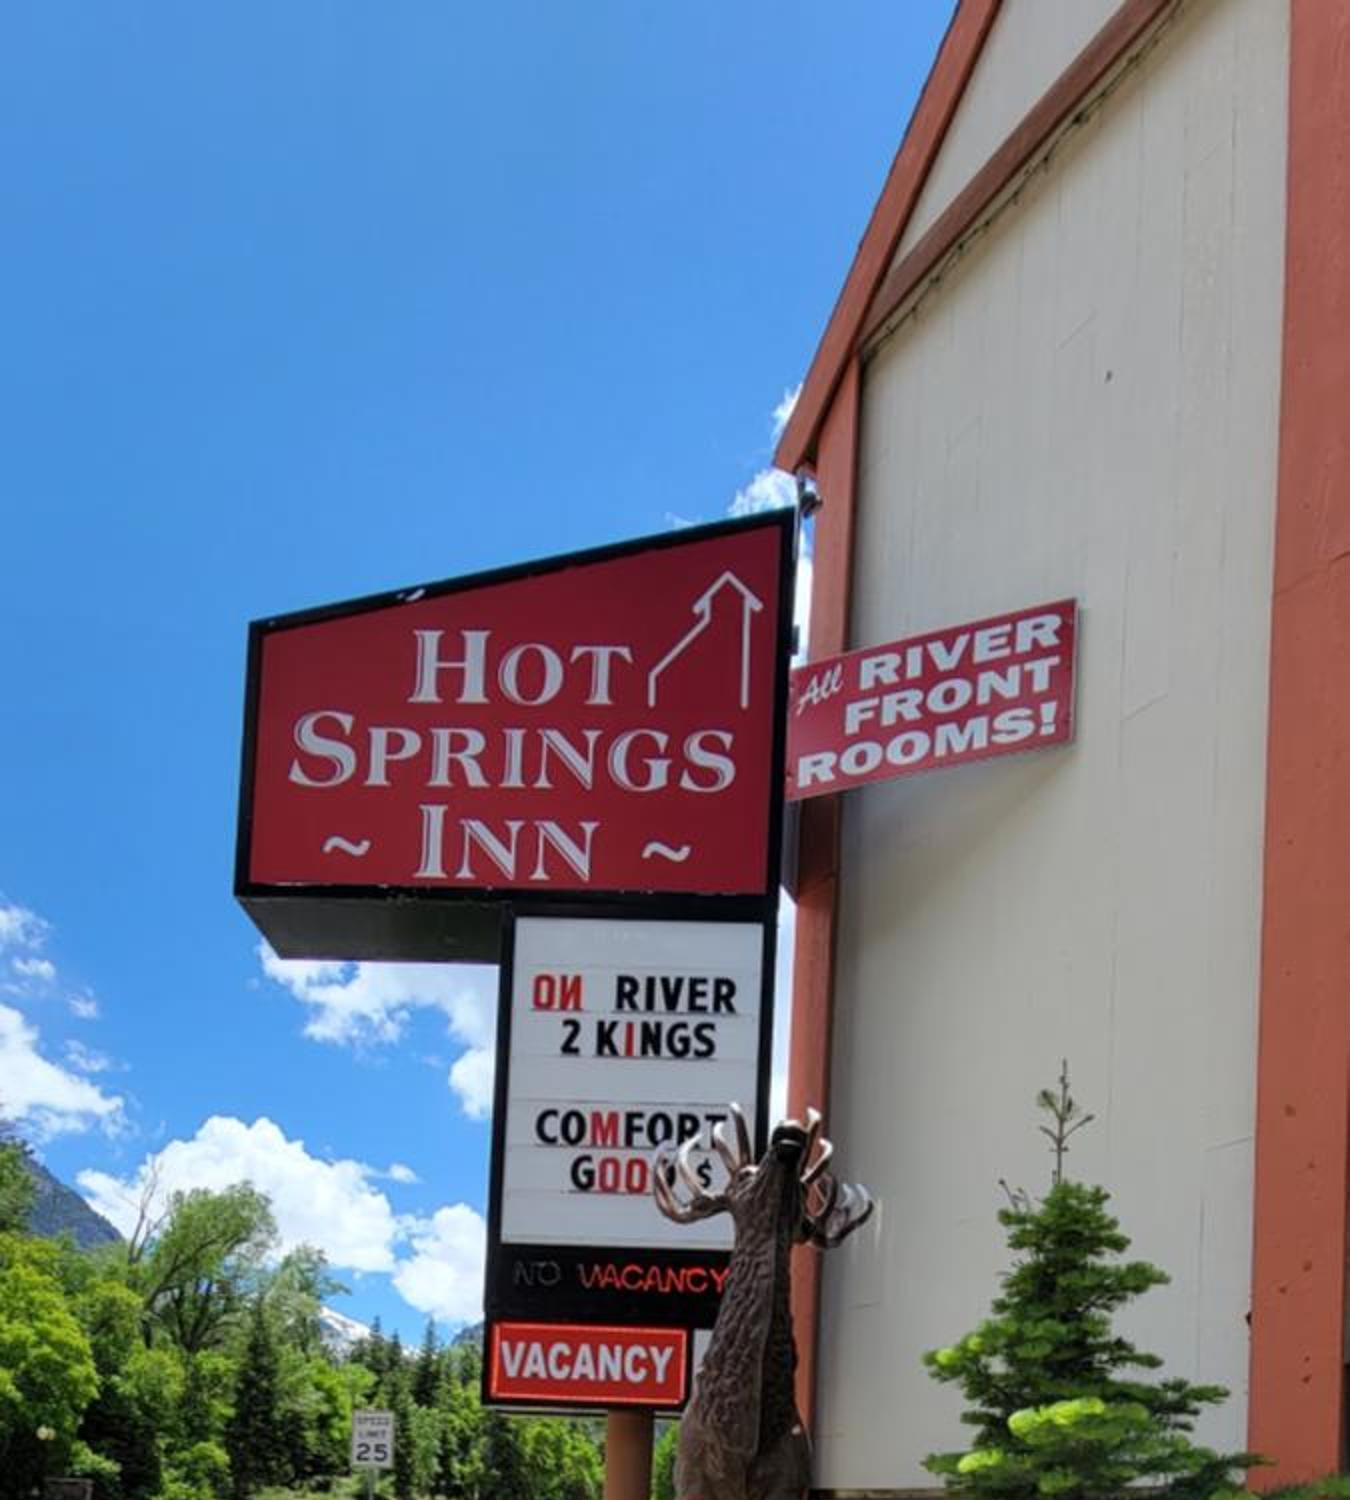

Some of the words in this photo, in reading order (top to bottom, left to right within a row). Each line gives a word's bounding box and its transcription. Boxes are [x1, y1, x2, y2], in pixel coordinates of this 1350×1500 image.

[407, 629, 634, 706] HOT
[859, 613, 1063, 691] RIVER
[844, 655, 1061, 736] FRONT
[288, 710, 737, 794] SPRINGS
[796, 700, 1058, 789] ROOMS!
[412, 803, 601, 882] INN
[531, 973, 584, 1012] ON
[614, 974, 738, 1015] RIVER
[559, 1018, 582, 1055] 2
[595, 1019, 717, 1059] KINGS
[534, 1108, 728, 1151] COMFORT
[513, 1259, 561, 1287] NO
[576, 1262, 732, 1294] VACANCY
[500, 1340, 674, 1384] VACANCY
[356, 1442, 389, 1462] 25
